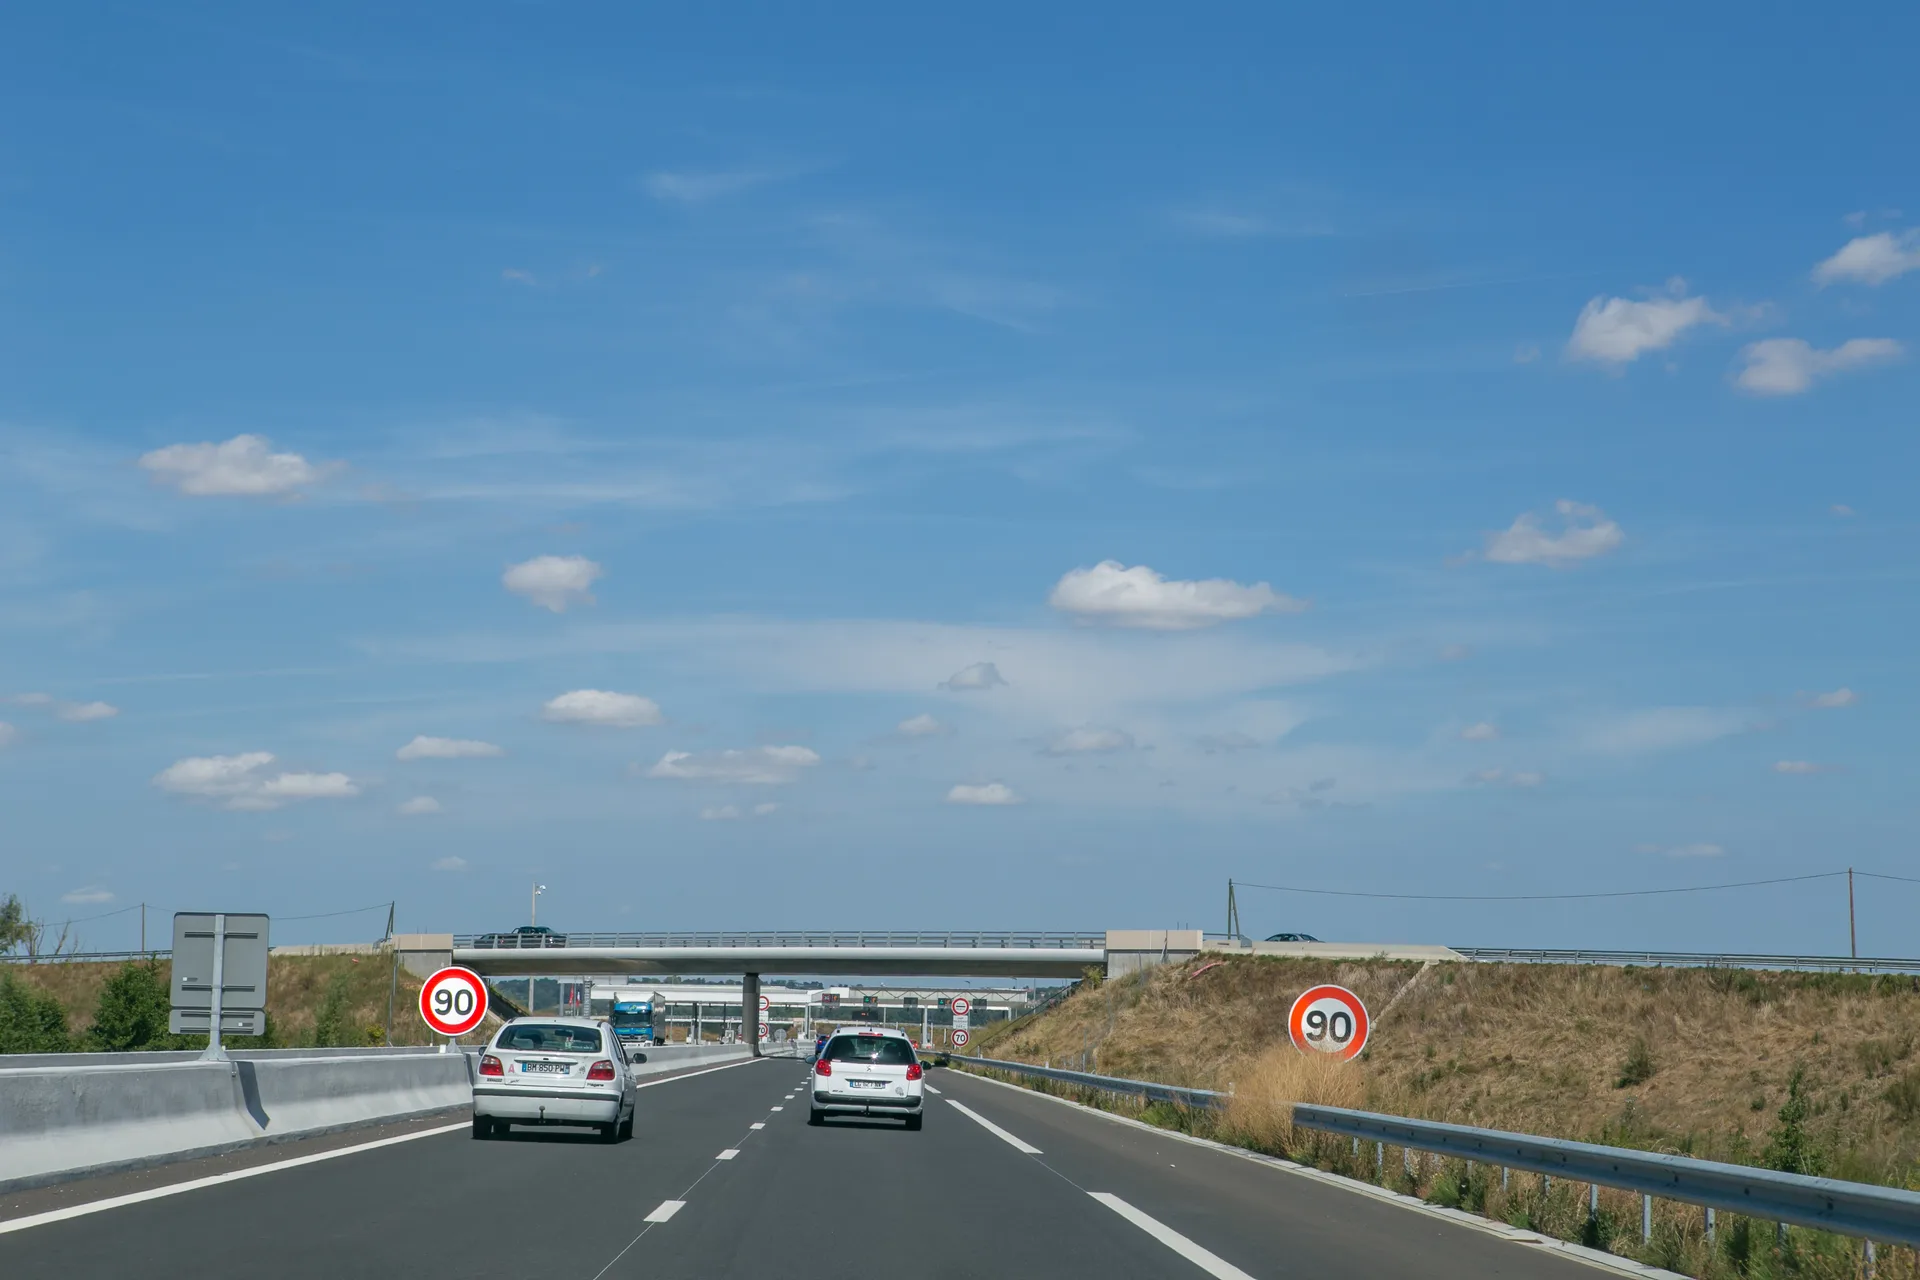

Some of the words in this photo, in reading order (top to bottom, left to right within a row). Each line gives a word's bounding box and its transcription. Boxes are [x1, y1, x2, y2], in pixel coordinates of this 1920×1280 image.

[434, 988, 474, 1016] 90
[1305, 1010, 1352, 1043] 90
[955, 1034, 966, 1042] 70
[527, 1063, 537, 1072] BM
[538, 1063, 554, 1072] 850
